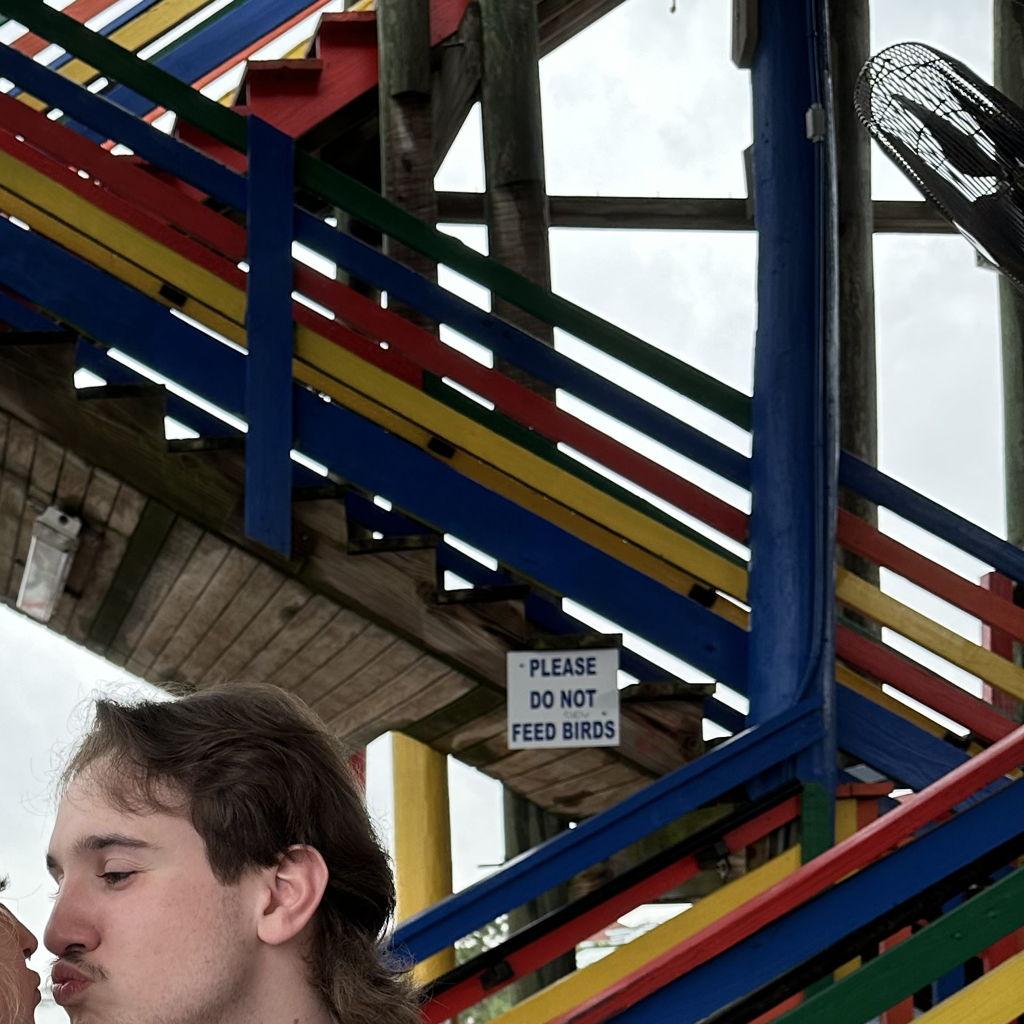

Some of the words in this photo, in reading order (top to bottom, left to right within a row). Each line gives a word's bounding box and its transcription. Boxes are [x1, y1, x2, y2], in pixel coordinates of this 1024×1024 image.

[529, 657, 597, 678] PLEASE
[530, 690, 555, 710] DO
[560, 689, 597, 709] NOT
[512, 722, 556, 742] FEED
[562, 720, 615, 740] BIRDS
